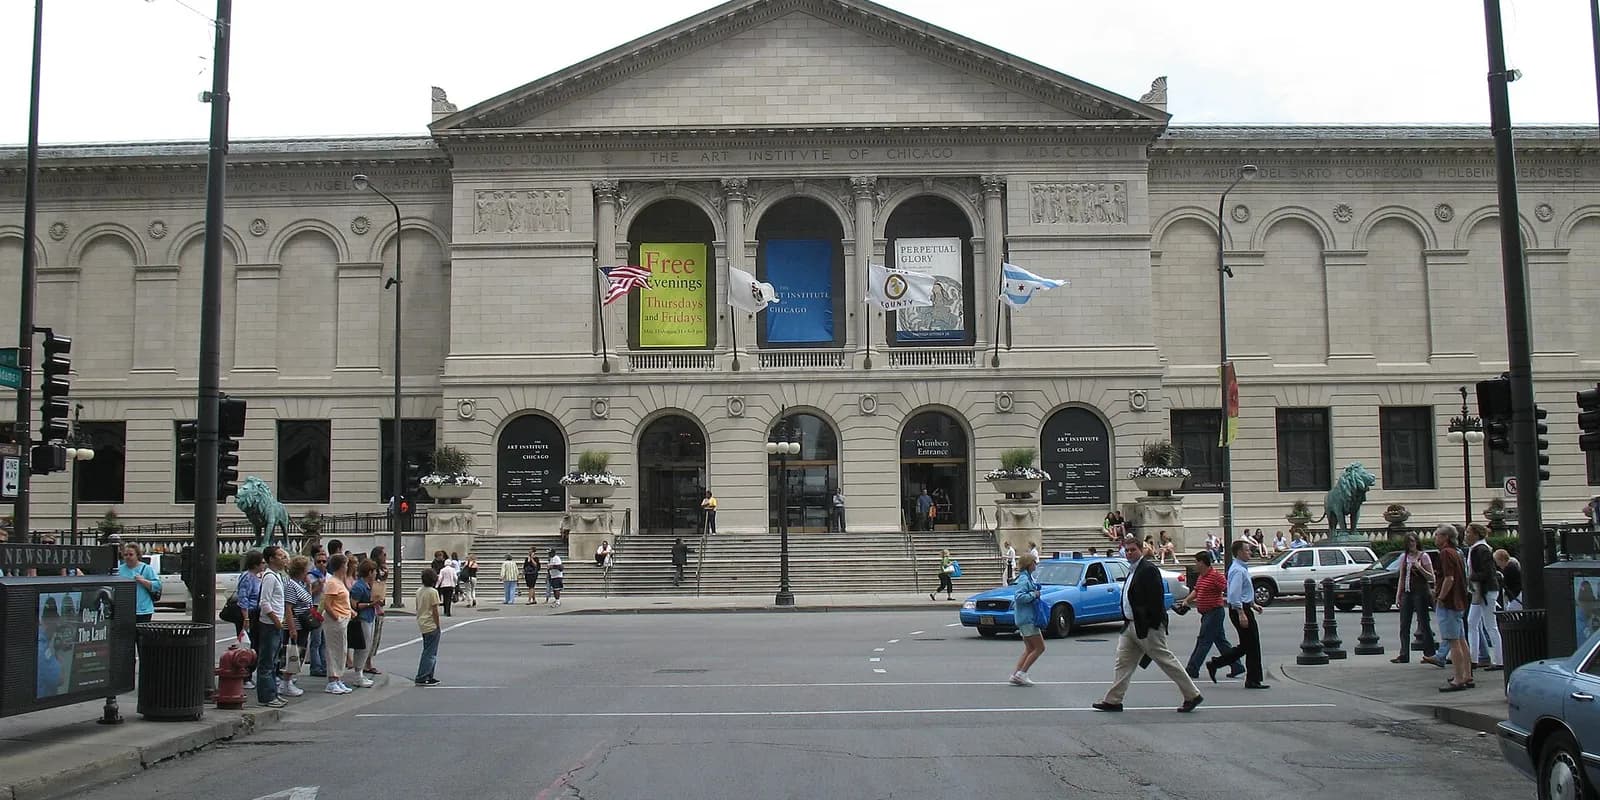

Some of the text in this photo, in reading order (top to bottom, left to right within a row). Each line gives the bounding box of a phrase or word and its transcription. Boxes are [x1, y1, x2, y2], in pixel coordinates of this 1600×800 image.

[520, 153, 575, 165] DOMINI
[651, 148, 952, 162] THE ART INSTITVTE OF CHICAGO
[1149, 167, 1191, 179] TITIAN
[1260, 168, 1286, 178] DEL
[1288, 167, 1331, 178] SARTO
[1345, 168, 1423, 178] CORREGGIO
[1438, 167, 1494, 178] HOLBEIN
[1516, 167, 1581, 178] ERONESE
[231, 181, 297, 193] MICHAEL
[383, 177, 450, 190] RAPHAEL
[901, 245, 956, 254] PERPETUAL
[645, 251, 695, 274] Free
[901, 255, 933, 263] GLORY
[645, 296, 703, 311] Thursdays
[645, 311, 702, 325] and Fridays
[917, 448, 948, 456] Entrance
[5, 548, 92, 564] NEWSPAPERS
[83, 608, 98, 625] Obey
[79, 627, 90, 642] The
